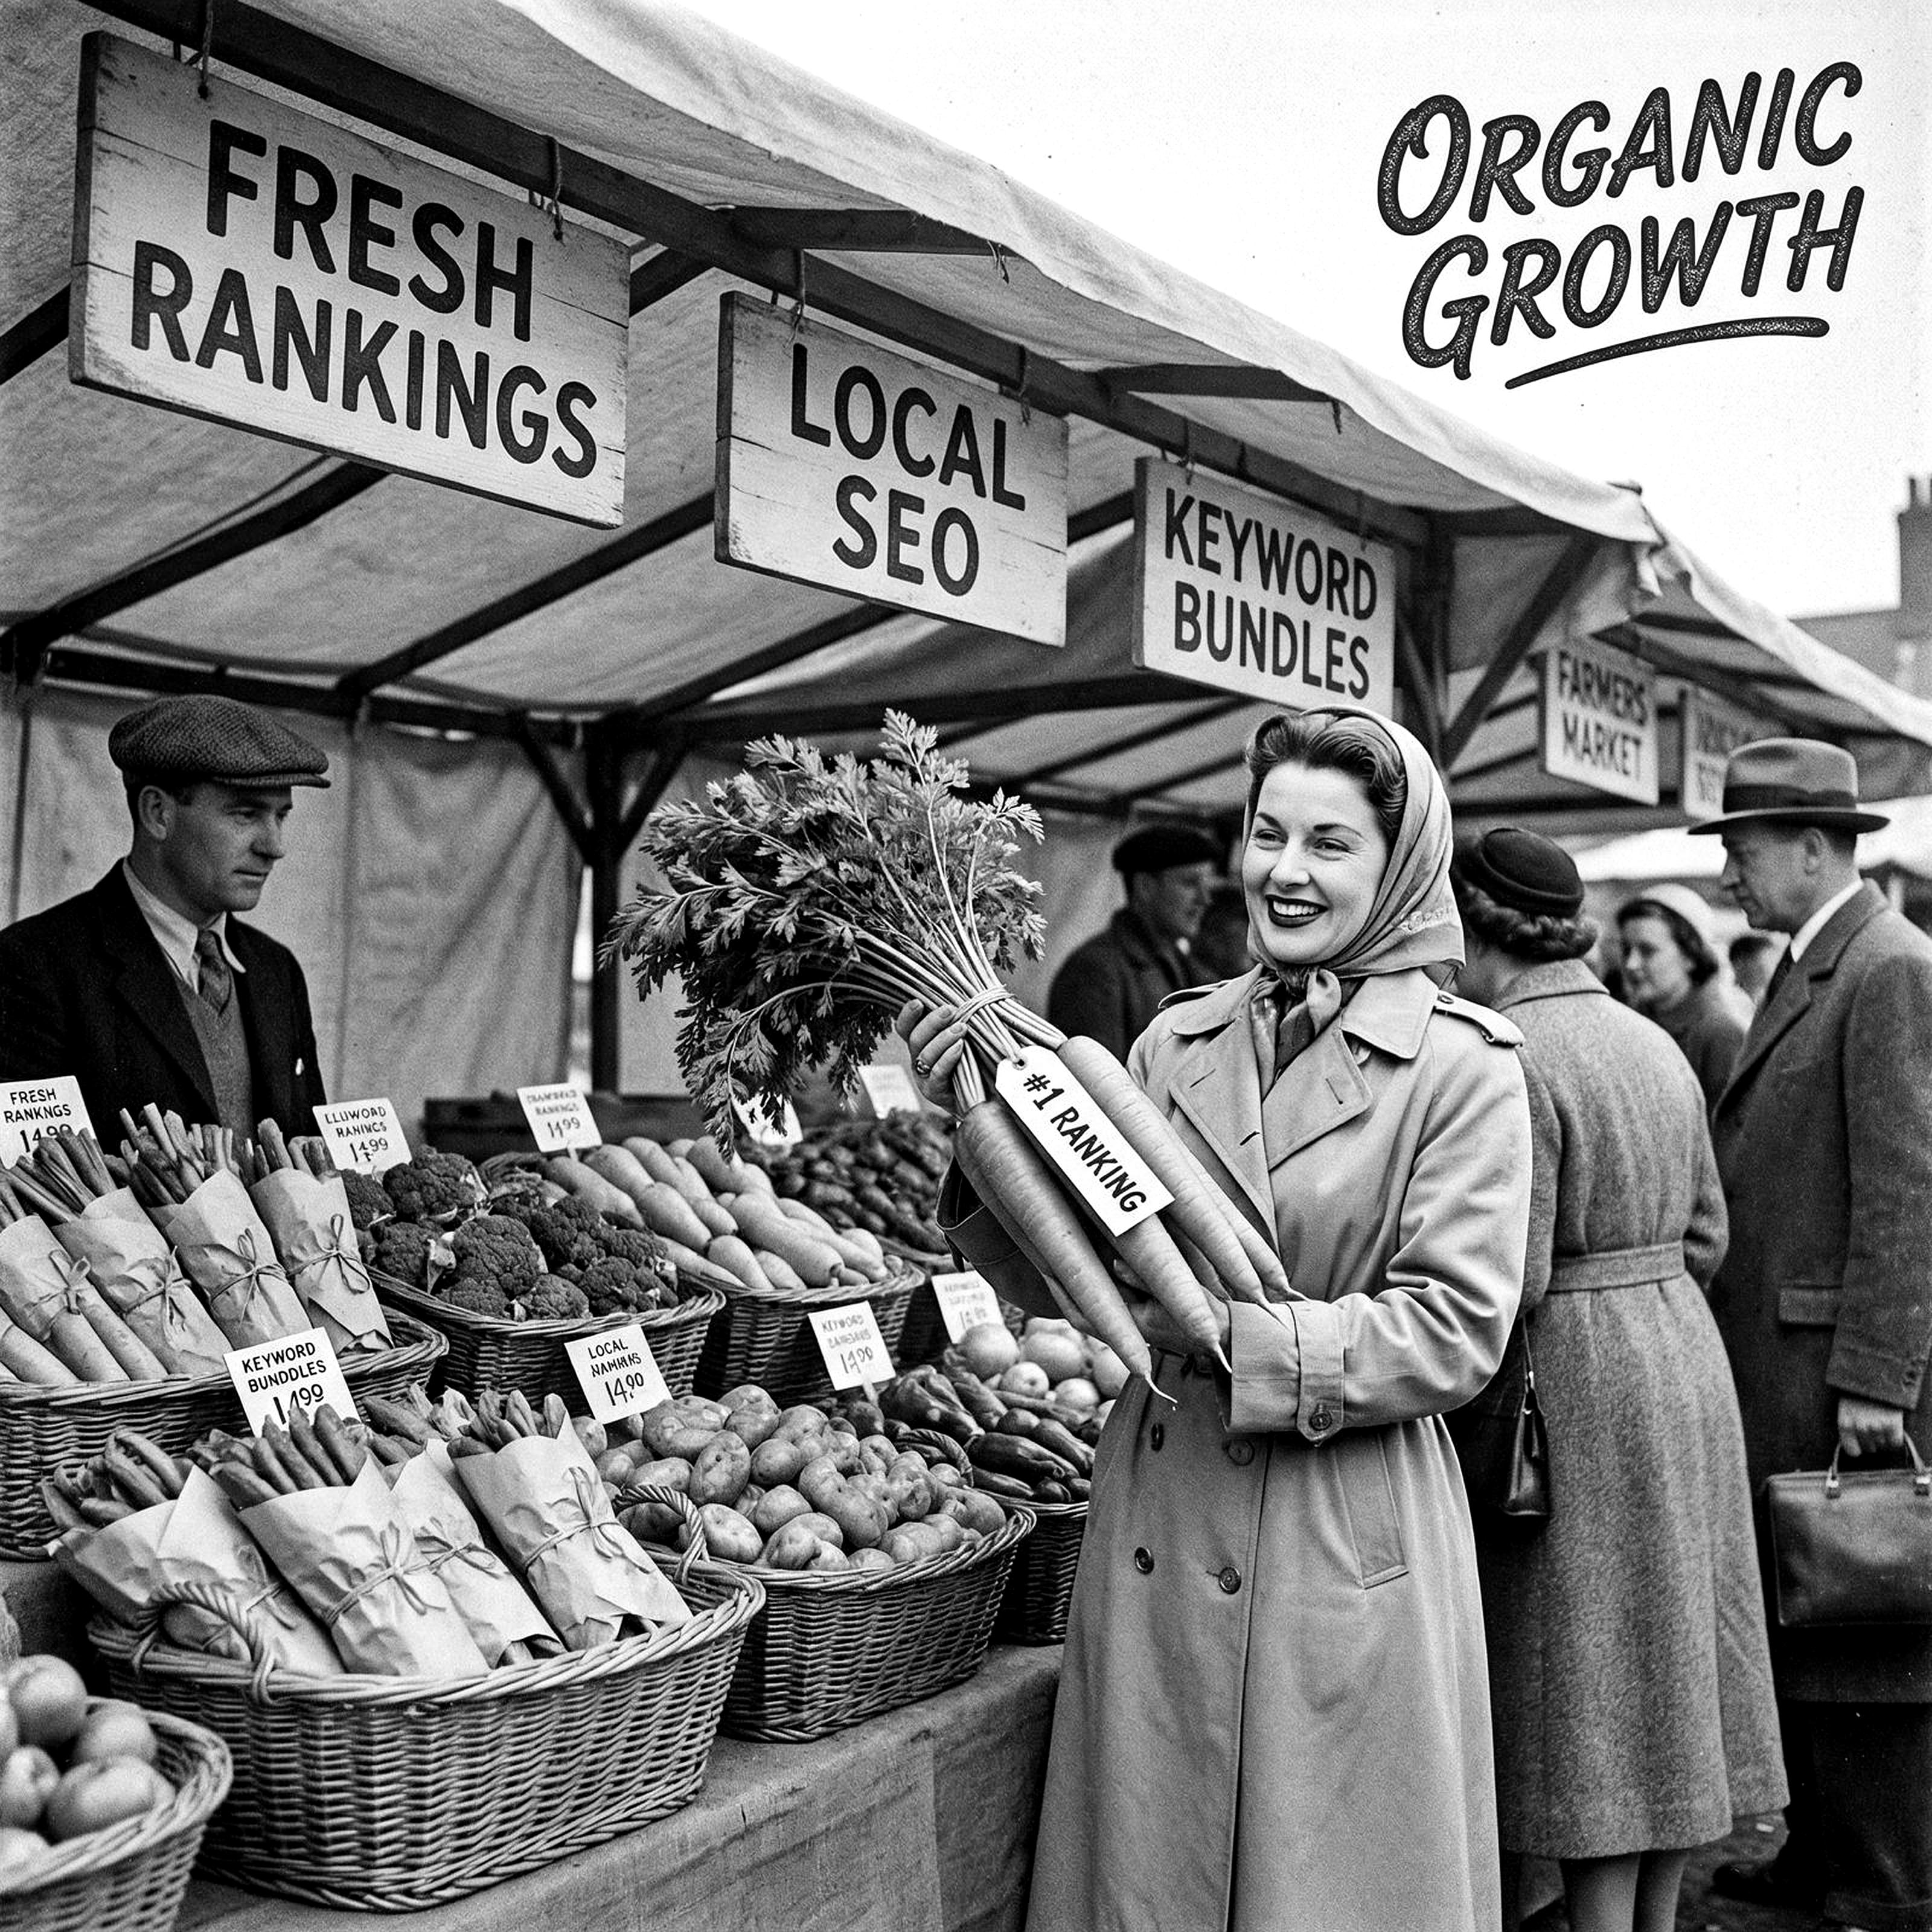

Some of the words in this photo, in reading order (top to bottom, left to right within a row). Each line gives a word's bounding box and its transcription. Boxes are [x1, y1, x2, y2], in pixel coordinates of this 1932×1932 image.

[207, 120, 533, 342] FRESH
[132, 240, 598, 479] RANKINGS
[792, 343, 1026, 511] LOCAL
[833, 475, 979, 597] SEO
[1165, 487, 1377, 620] KEYWORD
[1175, 580, 1369, 699] BUNDLES
[1559, 650, 1648, 727] FARMERS
[1563, 711, 1642, 782] MARKET
[4, 1104, 71, 1123] RANKNGS
[10, 1088, 57, 1105] FRESH
[1023, 1073, 1064, 1110] #1
[1050, 1106, 1147, 1212] RANKING
[242, 1342, 316, 1374] KEYWORD
[248, 1360, 327, 1393] BUNDDLES
[588, 1339, 629, 1359] LOCAL
